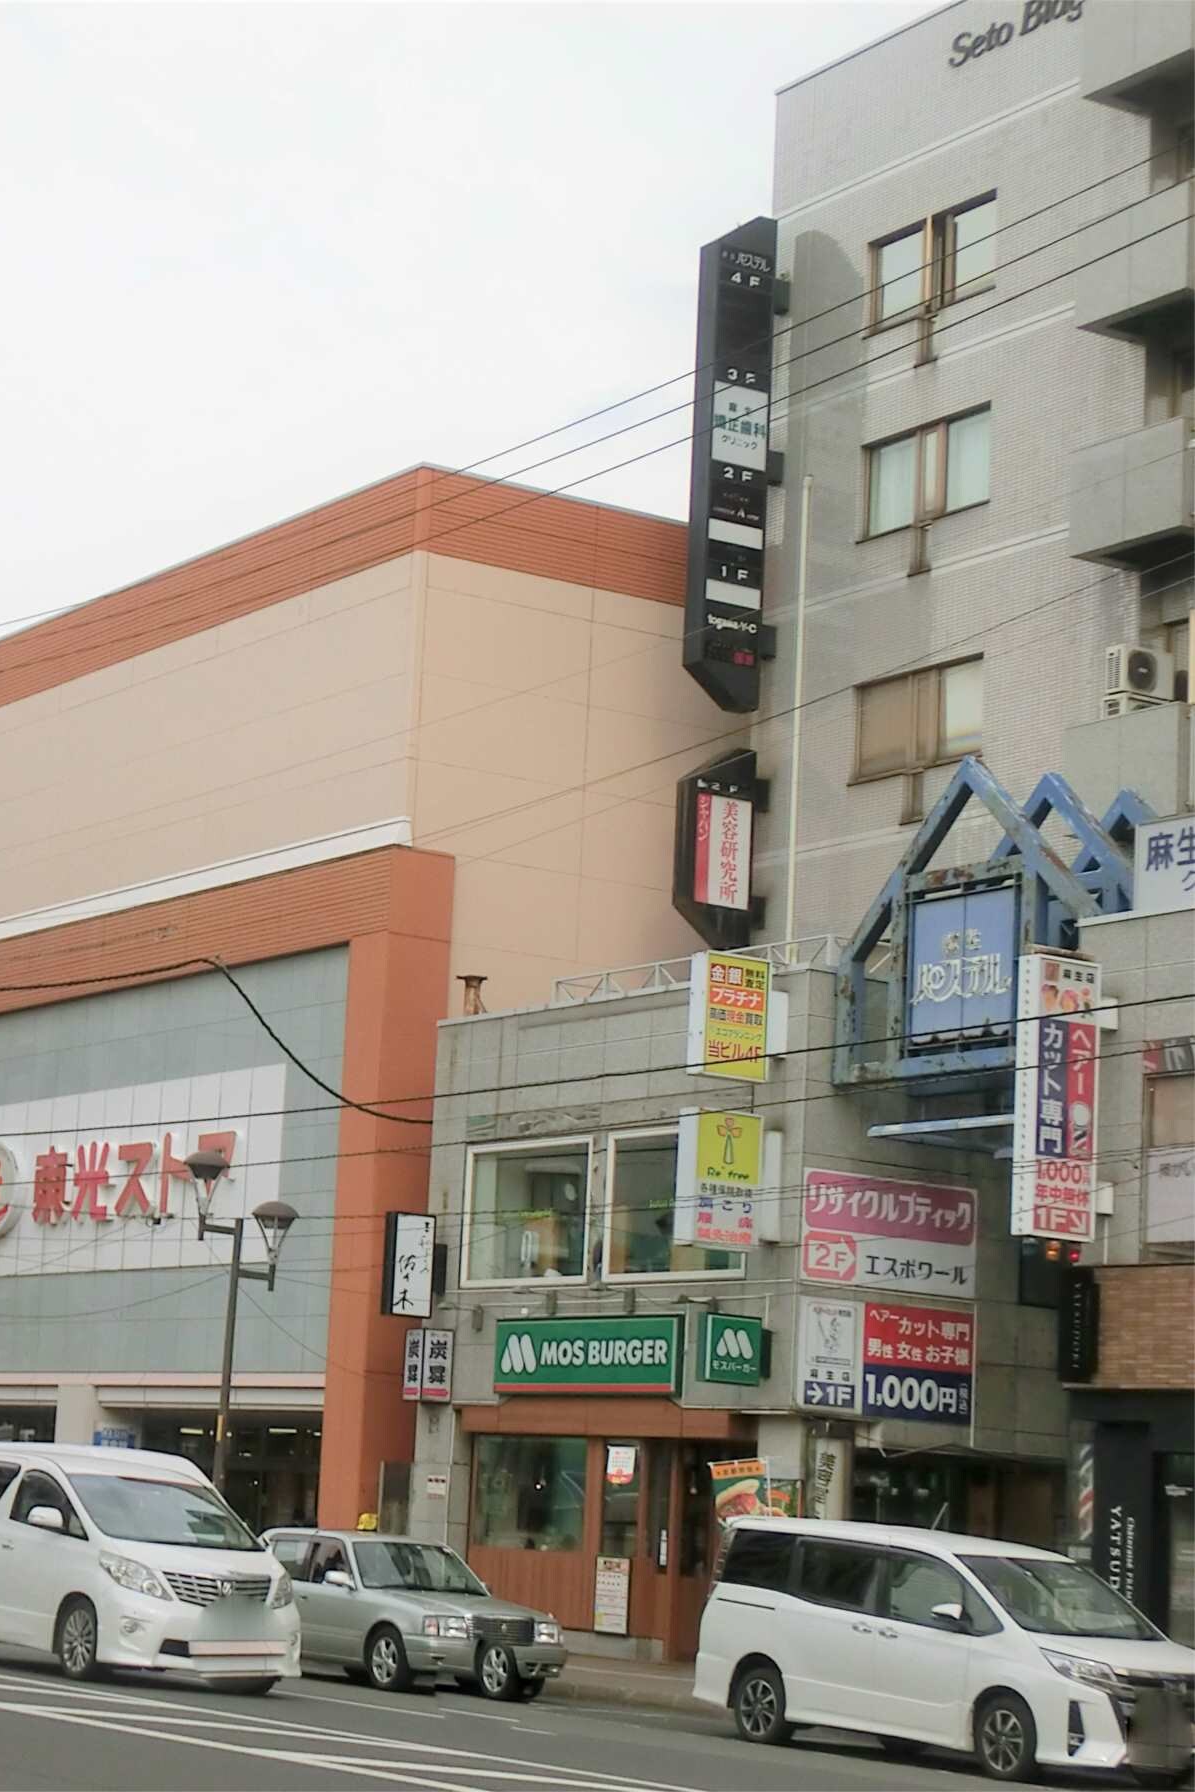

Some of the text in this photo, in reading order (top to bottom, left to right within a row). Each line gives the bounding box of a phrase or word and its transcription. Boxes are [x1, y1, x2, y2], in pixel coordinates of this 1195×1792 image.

[948, 22, 1014, 68] Seto
[721, 434, 759, 450] クリニック
[718, 801, 740, 905] 美容研究所
[711, 987, 762, 1009] プラチナ
[1070, 1028, 1093, 1096] ヘアー
[1039, 1022, 1064, 1154] カット専門
[31, 1130, 239, 1226] 東光ストア
[1036, 1207, 1068, 1231] 1F
[815, 1243, 848, 1269] 2F
[865, 1255, 968, 1286] エスポワール
[869, 1308, 970, 1342] ヘアーカット専門
[540, 1339, 584, 1366] MOS
[587, 1338, 668, 1366] BURGER
[712, 1359, 758, 1374] モスバーガー
[867, 1338, 970, 1366] 男性 女性 お子様
[826, 1385, 853, 1406] 1F
[865, 1373, 957, 1414] 1,000円
